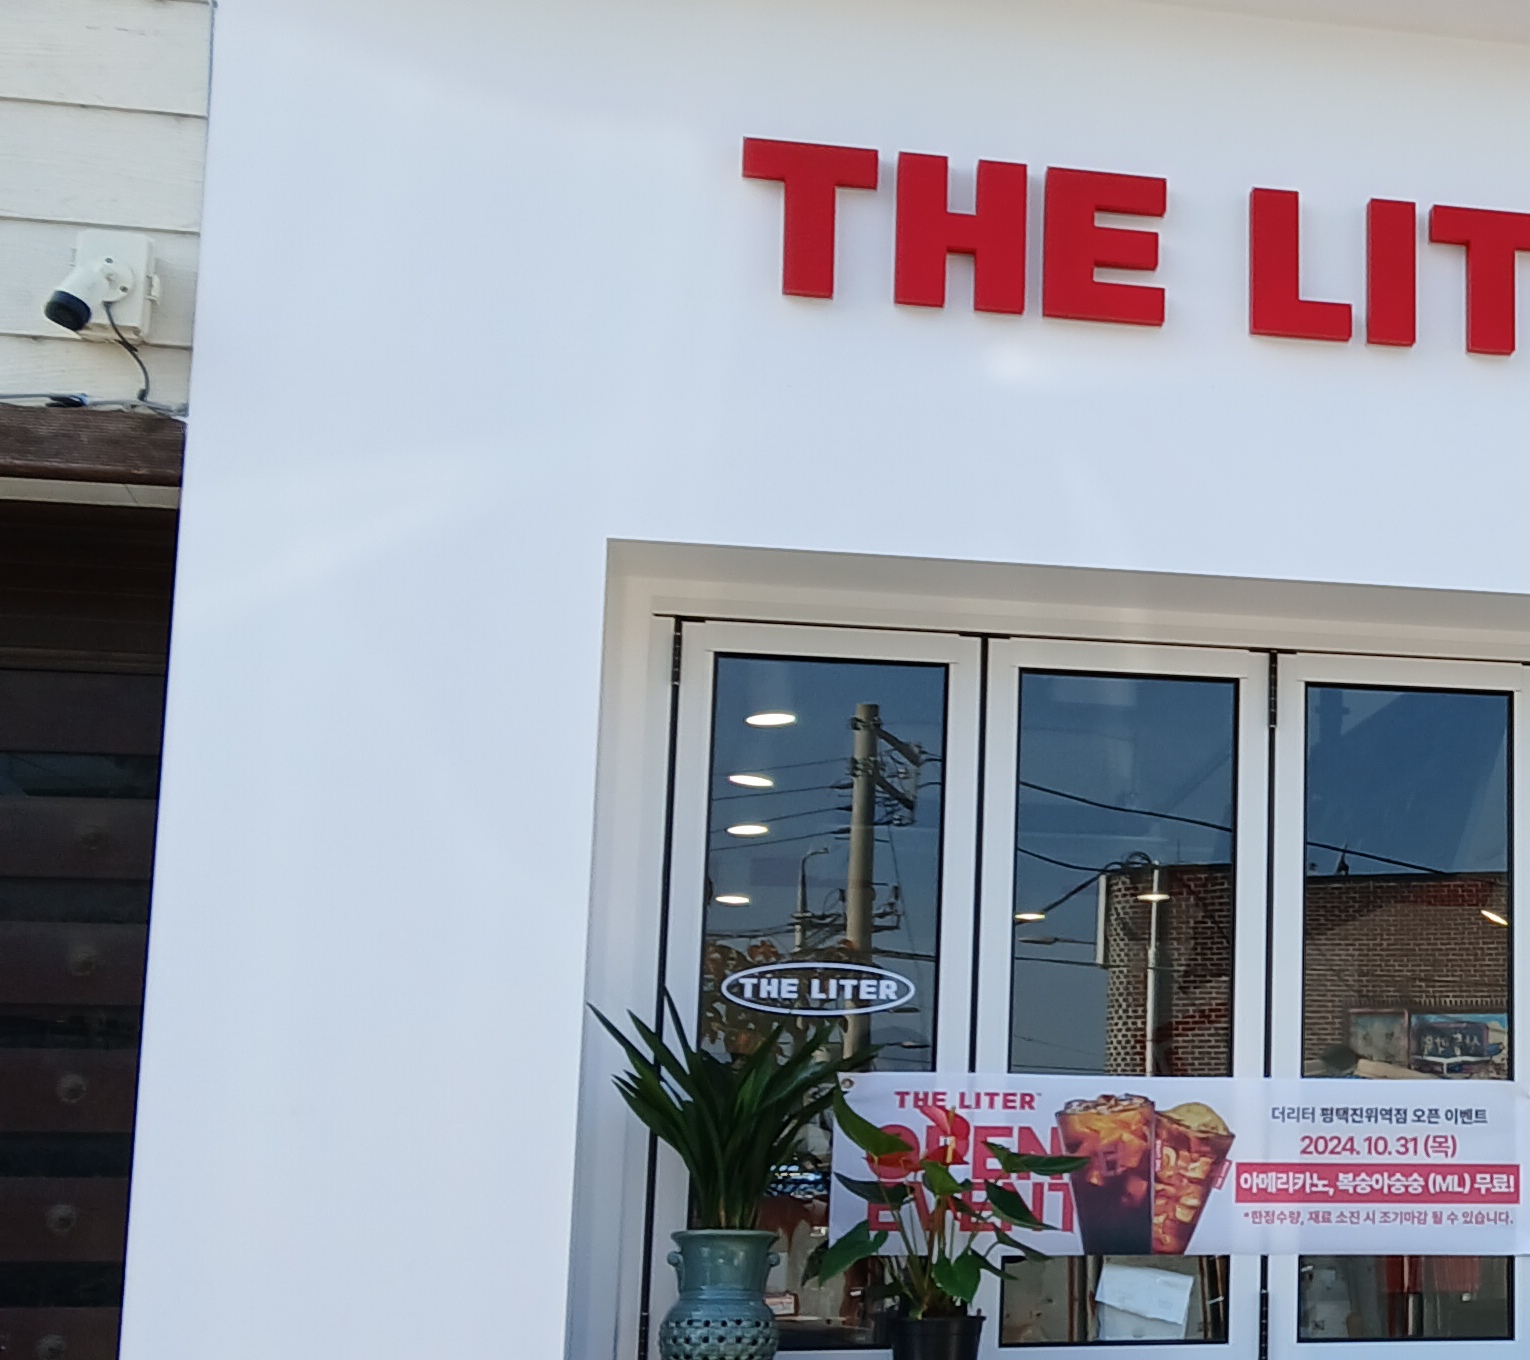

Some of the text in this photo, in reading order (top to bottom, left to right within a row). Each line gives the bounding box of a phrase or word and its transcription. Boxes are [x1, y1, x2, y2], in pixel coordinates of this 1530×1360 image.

[742, 136, 1167, 326] THE
[738, 977, 899, 1001] THE LITER
[894, 1091, 1036, 1110] THE LITER
[1271, 1106, 1488, 1125] 더리터 평택진위역점 오픈 이벤트
[1239, 1171, 1334, 1196] 아메리카노,
[1428, 1172, 1471, 1195] (ML)
[1474, 1172, 1516, 1195] 무료!
[1335, 1210, 1361, 1225] 소진
[1363, 1210, 1376, 1225] 시
[1446, 1211, 1459, 1225] 수
[1461, 1210, 1514, 1225] 있습니다.
